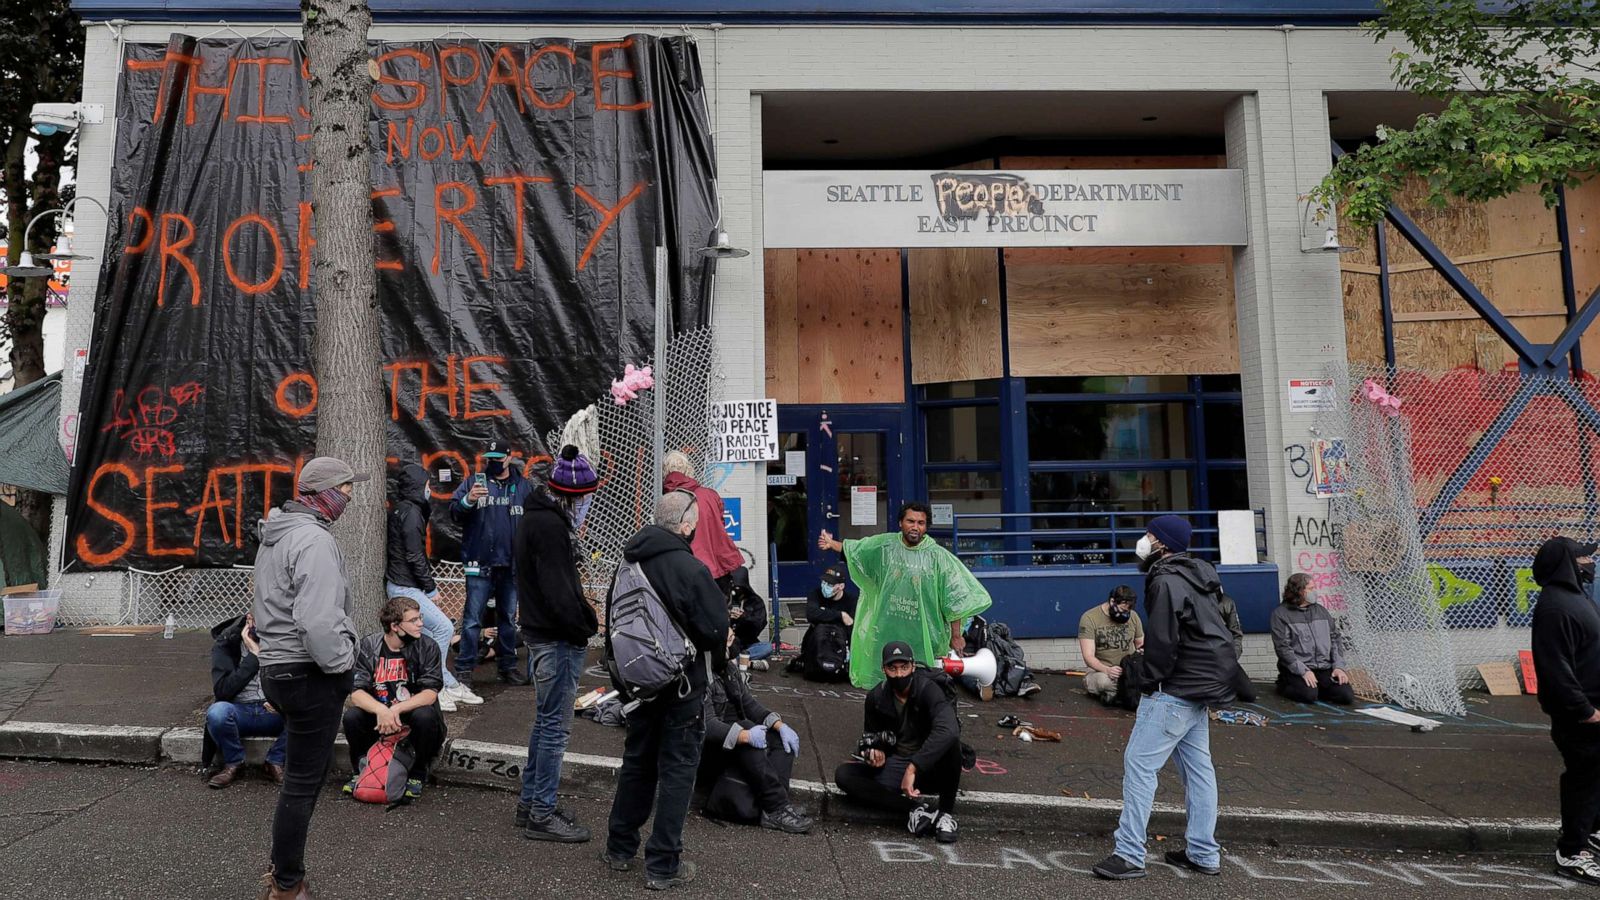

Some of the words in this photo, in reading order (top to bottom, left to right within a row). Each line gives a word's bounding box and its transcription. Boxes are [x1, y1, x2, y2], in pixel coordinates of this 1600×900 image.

[127, 52, 312, 126] THI
[371, 37, 653, 114] SPACE
[386, 117, 497, 164] NOW
[826, 184, 923, 202] SEATTLE
[1034, 183, 1184, 202] DEPARTMENT
[917, 215, 972, 233] EAST
[986, 214, 1097, 233] PRECINCT
[275, 373, 318, 418] O
[384, 354, 512, 421] THE
[722, 402, 773, 418] JUSTICE
[731, 419, 768, 434] PEACE
[726, 434, 769, 448] RACIST
[768, 475, 794, 485] SEATTLE
[77, 455, 399, 566] SEATT
[1225, 854, 1579, 888] LIVES
